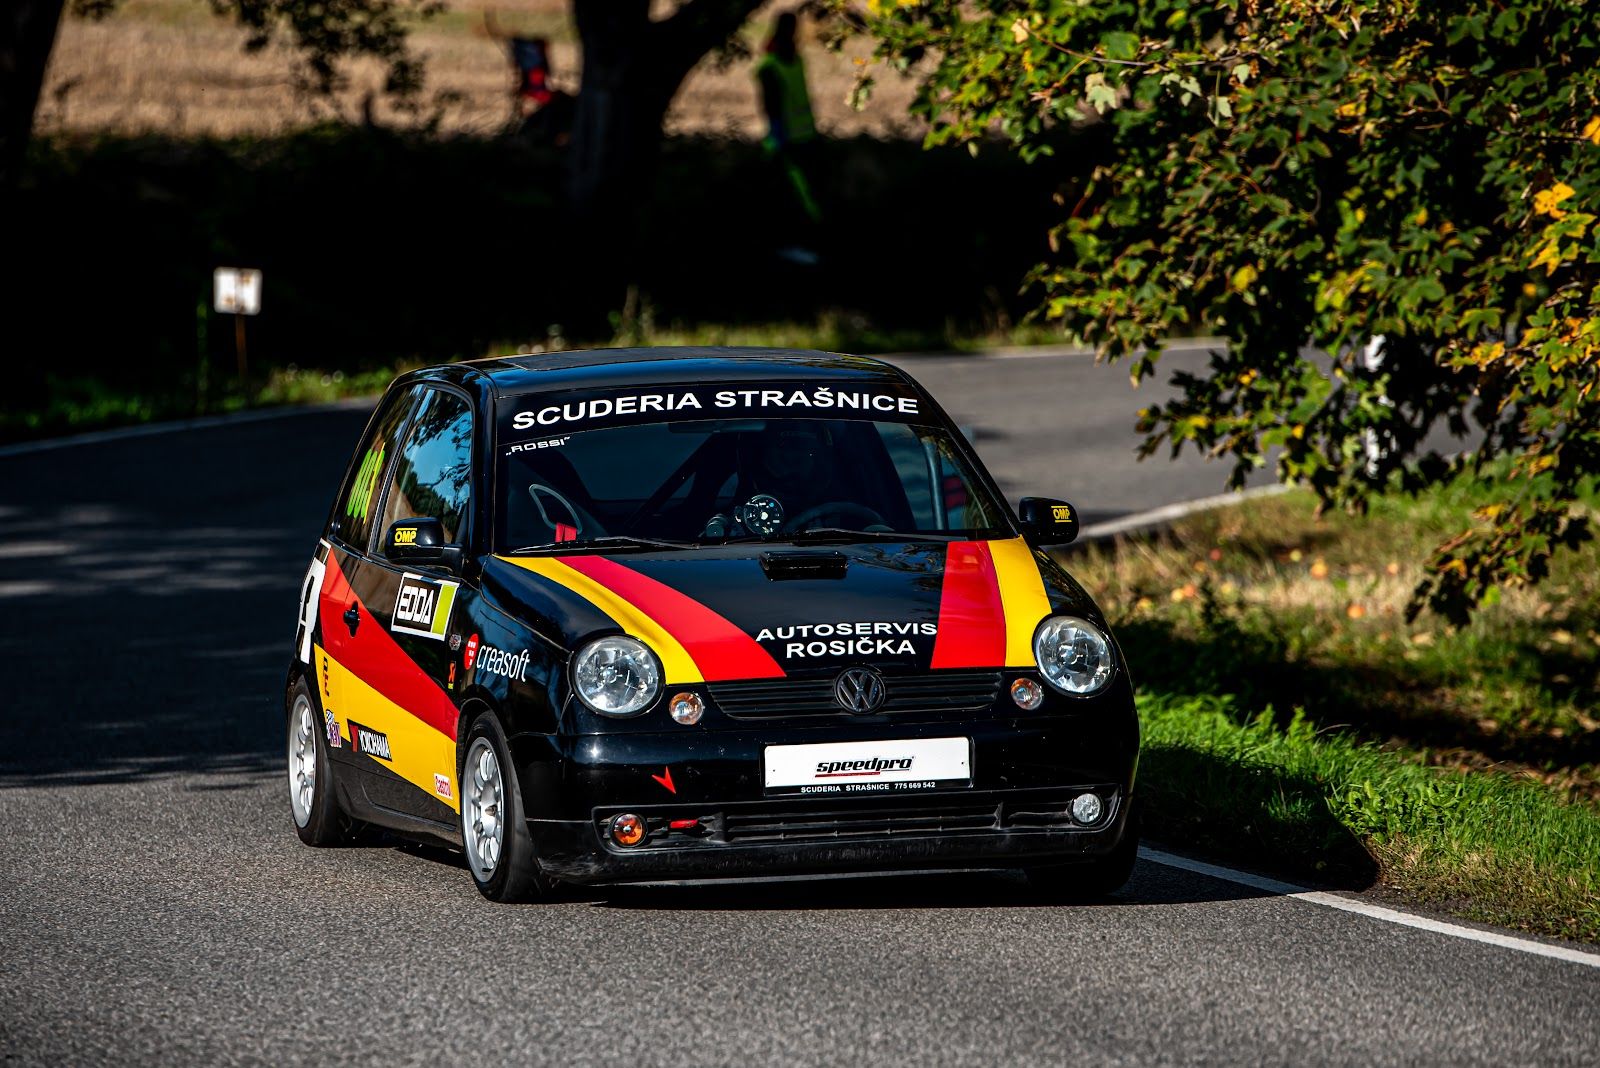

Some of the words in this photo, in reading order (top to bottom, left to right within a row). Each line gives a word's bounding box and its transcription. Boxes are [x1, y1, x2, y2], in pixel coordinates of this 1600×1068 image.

[512, 392, 702, 430] SCUDERIA
[714, 387, 919, 414] STRAŠNICE
[1052, 507, 1071, 520] OMP
[394, 530, 417, 544] OMP
[396, 585, 435, 625] EDDA
[755, 622, 938, 642] AUTOSERVIS
[786, 636, 916, 659] ROSIČKA
[476, 644, 531, 683] creasoft
[816, 757, 913, 774] speedpro
[800, 786, 841, 794] SCUDERIA
[845, 782, 890, 793] STRAŠNICE
[894, 782, 908, 790] 775
[922, 781, 936, 789] 542
